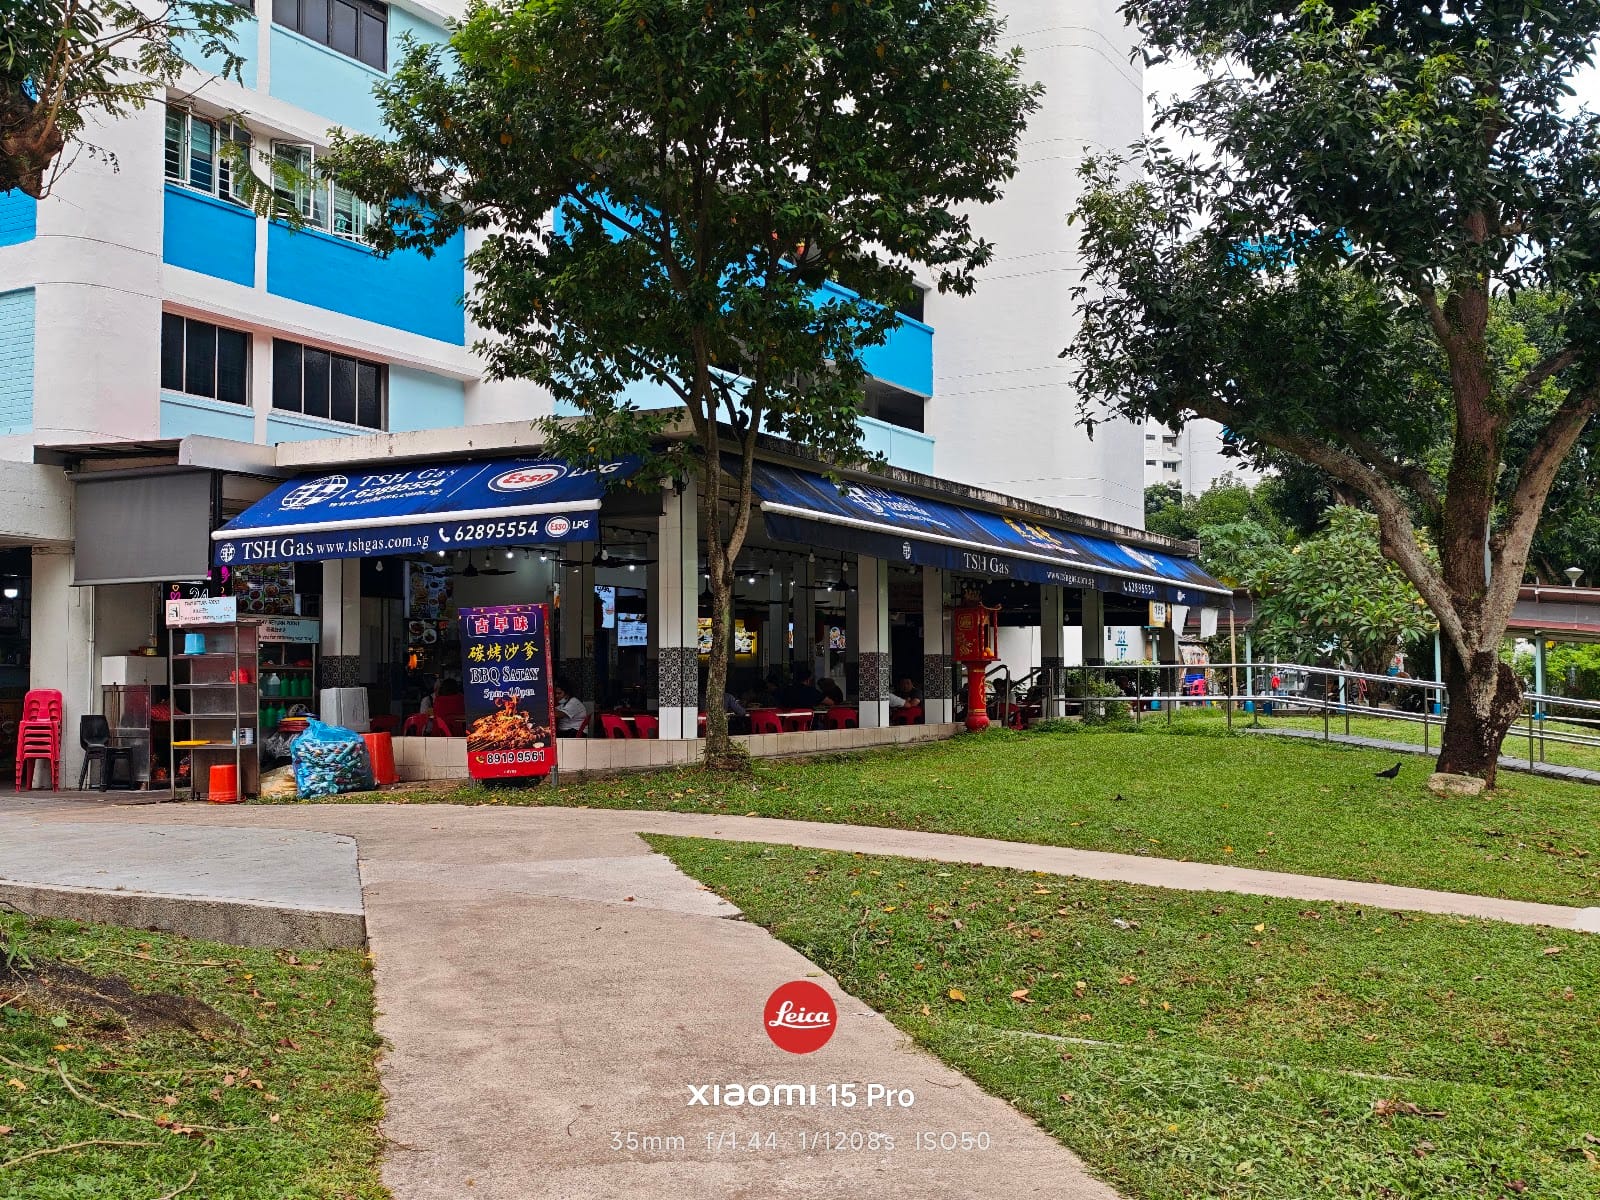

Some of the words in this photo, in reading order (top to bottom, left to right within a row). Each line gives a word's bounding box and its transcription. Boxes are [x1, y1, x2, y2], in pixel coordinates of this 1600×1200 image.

[360, 471, 412, 487] TSH
[417, 467, 459, 480] Gas
[502, 472, 554, 484] Esso
[454, 521, 539, 542] 62895554
[572, 519, 589, 530] LPG
[242, 540, 277, 560] TSH
[280, 538, 314, 557] Gas
[316, 534, 429, 555] www.tshgas.com.sg
[963, 552, 987, 571] TSH
[989, 557, 1009, 575] Gas
[474, 615, 529, 635] 古早味
[467, 640, 539, 663] 碳烤沙爹
[470, 667, 501, 686] BBQ
[487, 752, 516, 765] 8919
[517, 750, 545, 764] 9561
